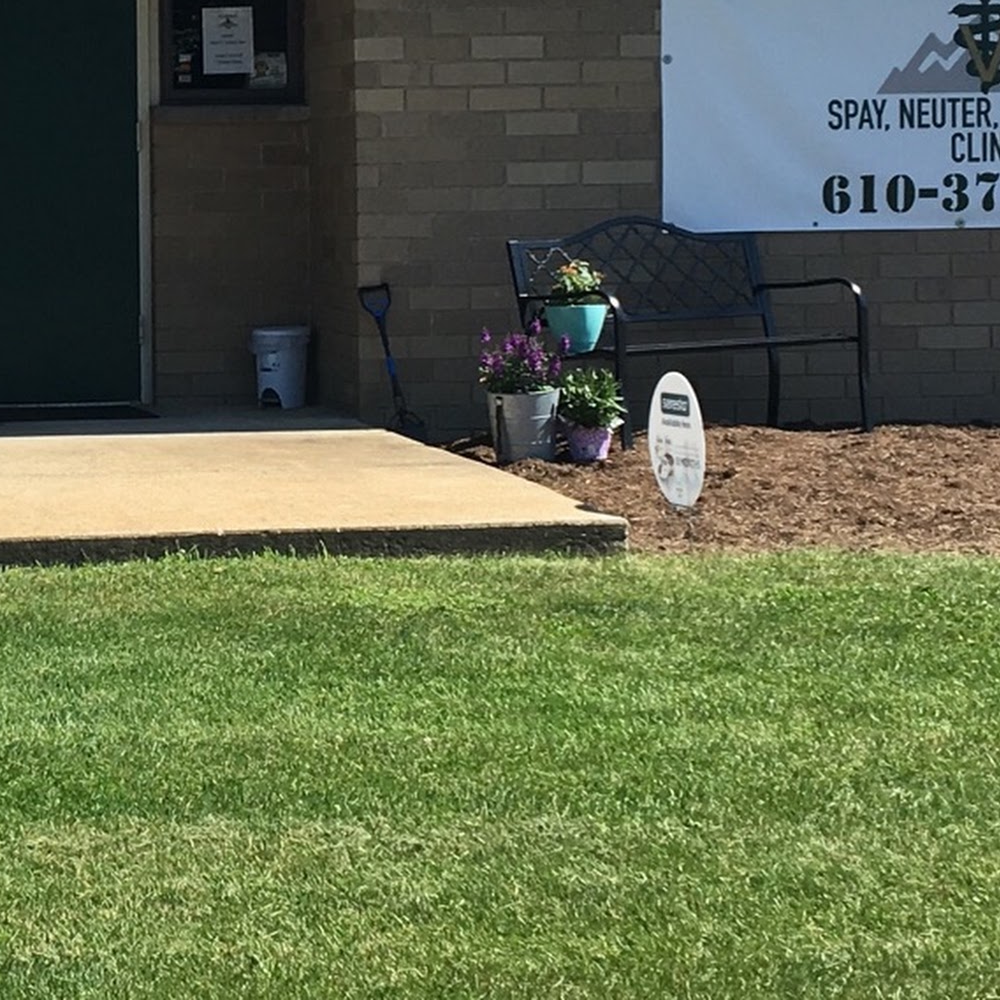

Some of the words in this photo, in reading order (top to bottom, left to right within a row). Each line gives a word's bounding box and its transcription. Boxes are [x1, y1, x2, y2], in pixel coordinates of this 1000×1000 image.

[828, 98, 891, 131] SPAY,
[899, 97, 999, 130] NEUTER,
[822, 172, 1000, 214] 610-37
